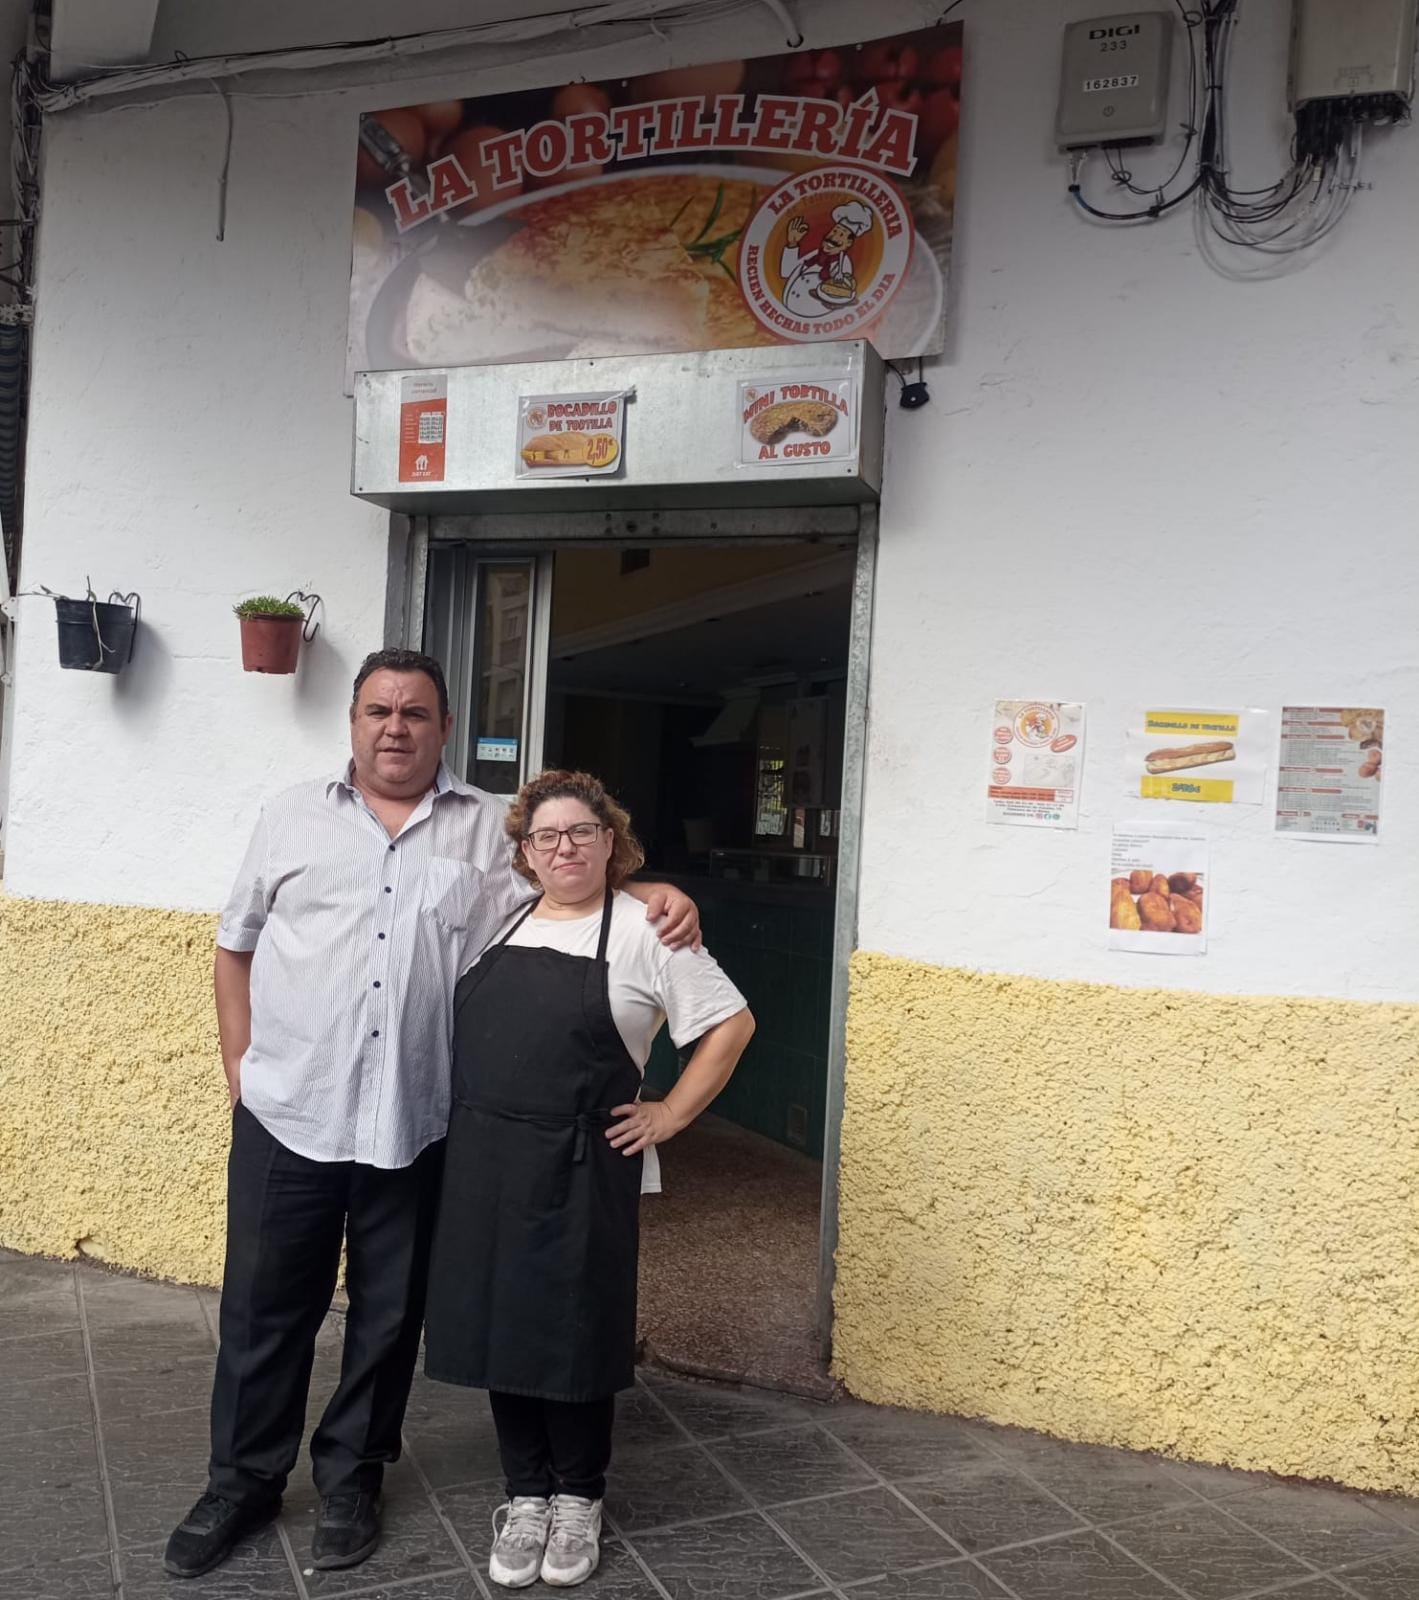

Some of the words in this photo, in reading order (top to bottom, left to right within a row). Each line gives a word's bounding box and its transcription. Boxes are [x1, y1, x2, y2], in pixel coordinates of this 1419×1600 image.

[1089, 24, 1140, 40] DIGI
[1101, 40, 1127, 52] 233
[1086, 76, 1137, 90] 162837
[386, 155, 477, 232] LA
[479, 88, 918, 191] TORTILLERÍA
[768, 189, 795, 215] LA
[795, 173, 903, 240] TORTILLERIA
[747, 245, 766, 301] RECIEN
[759, 301, 809, 334] HECHAS
[813, 313, 854, 334] TODO
[857, 301, 875, 318] EL
[872, 273, 896, 303] DIA
[547, 401, 617, 418] BOCADILLO
[780, 384, 849, 417] TORTILLA
[549, 420, 562, 431] DE
[566, 417, 613, 431] TORTILLA
[759, 446, 779, 460] AL
[783, 441, 832, 458] GUSTO
